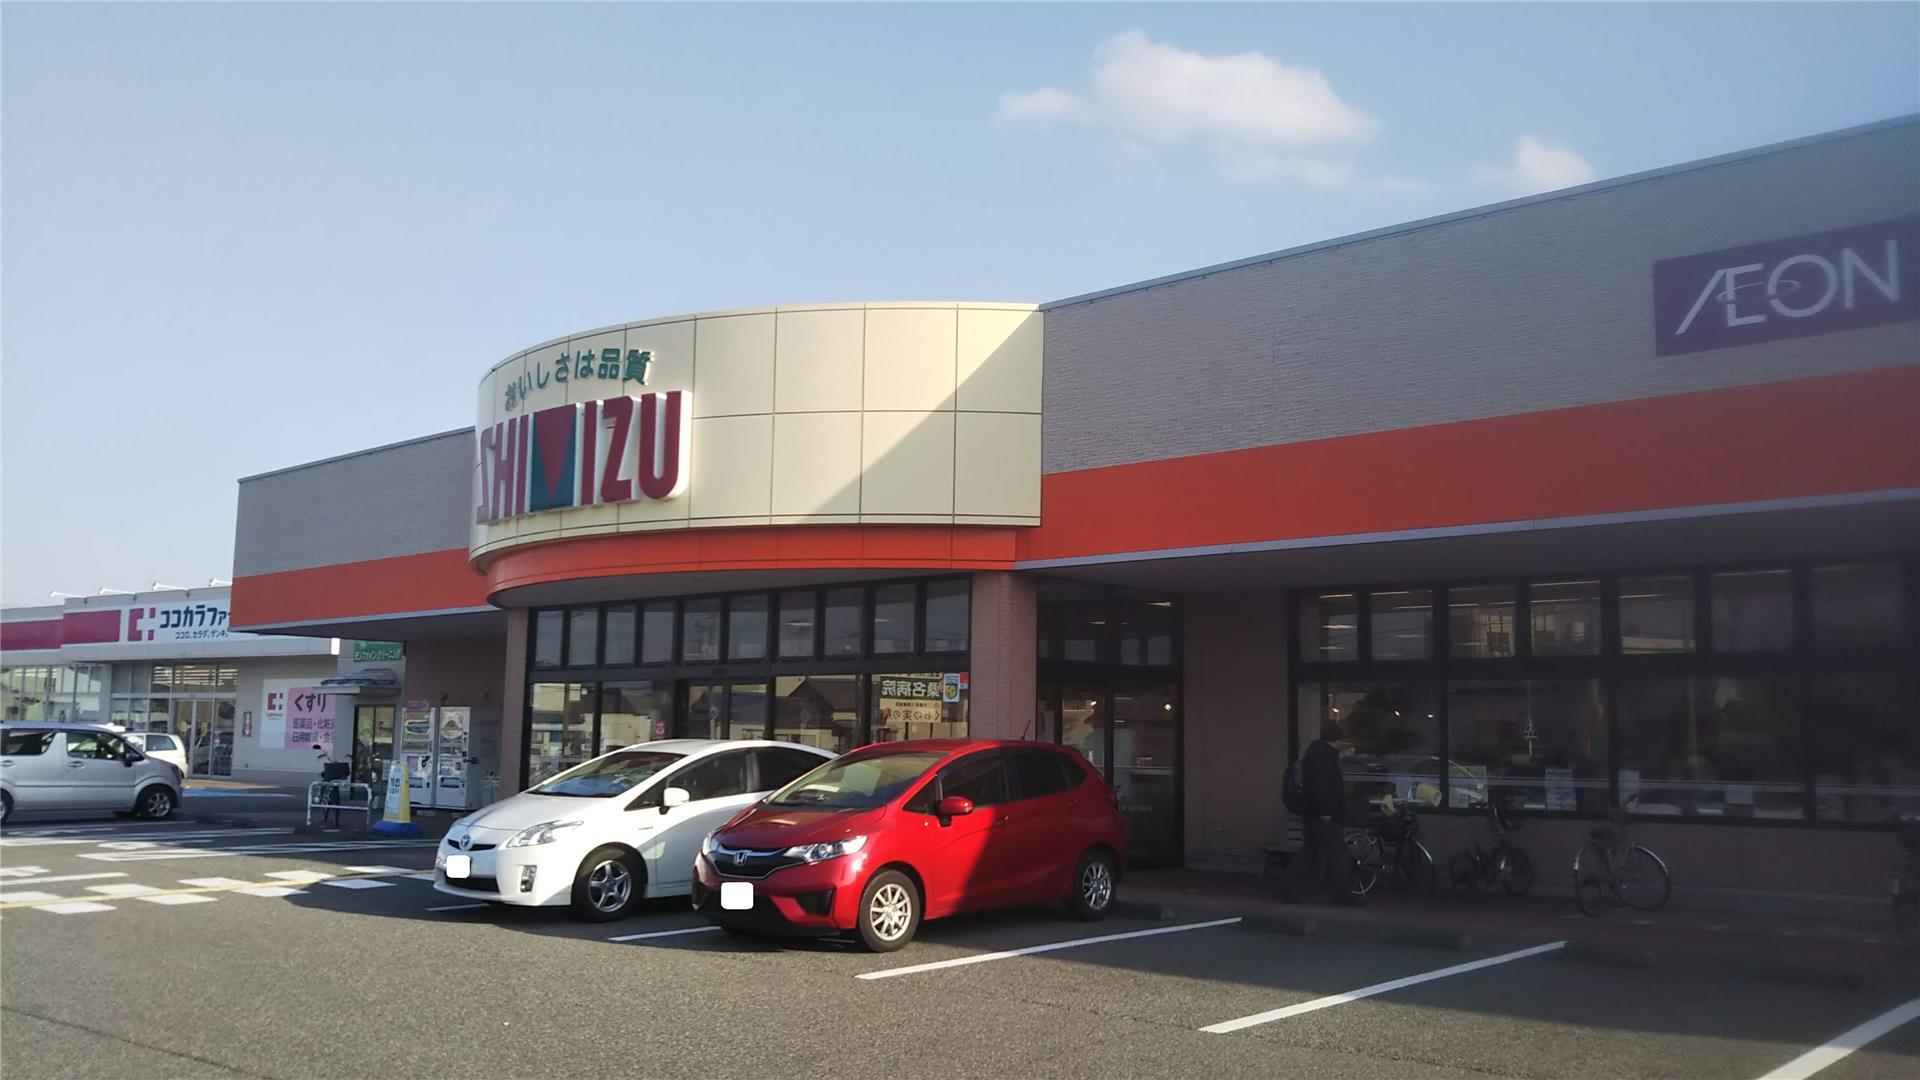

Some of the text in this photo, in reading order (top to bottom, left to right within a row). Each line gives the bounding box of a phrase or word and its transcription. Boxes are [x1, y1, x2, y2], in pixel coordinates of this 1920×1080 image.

[505, 348, 655, 411] おいしさは品質
[477, 390, 690, 525] SHIMIZU
[160, 604, 231, 628] ココカラファ
[294, 693, 327, 712] くすり
